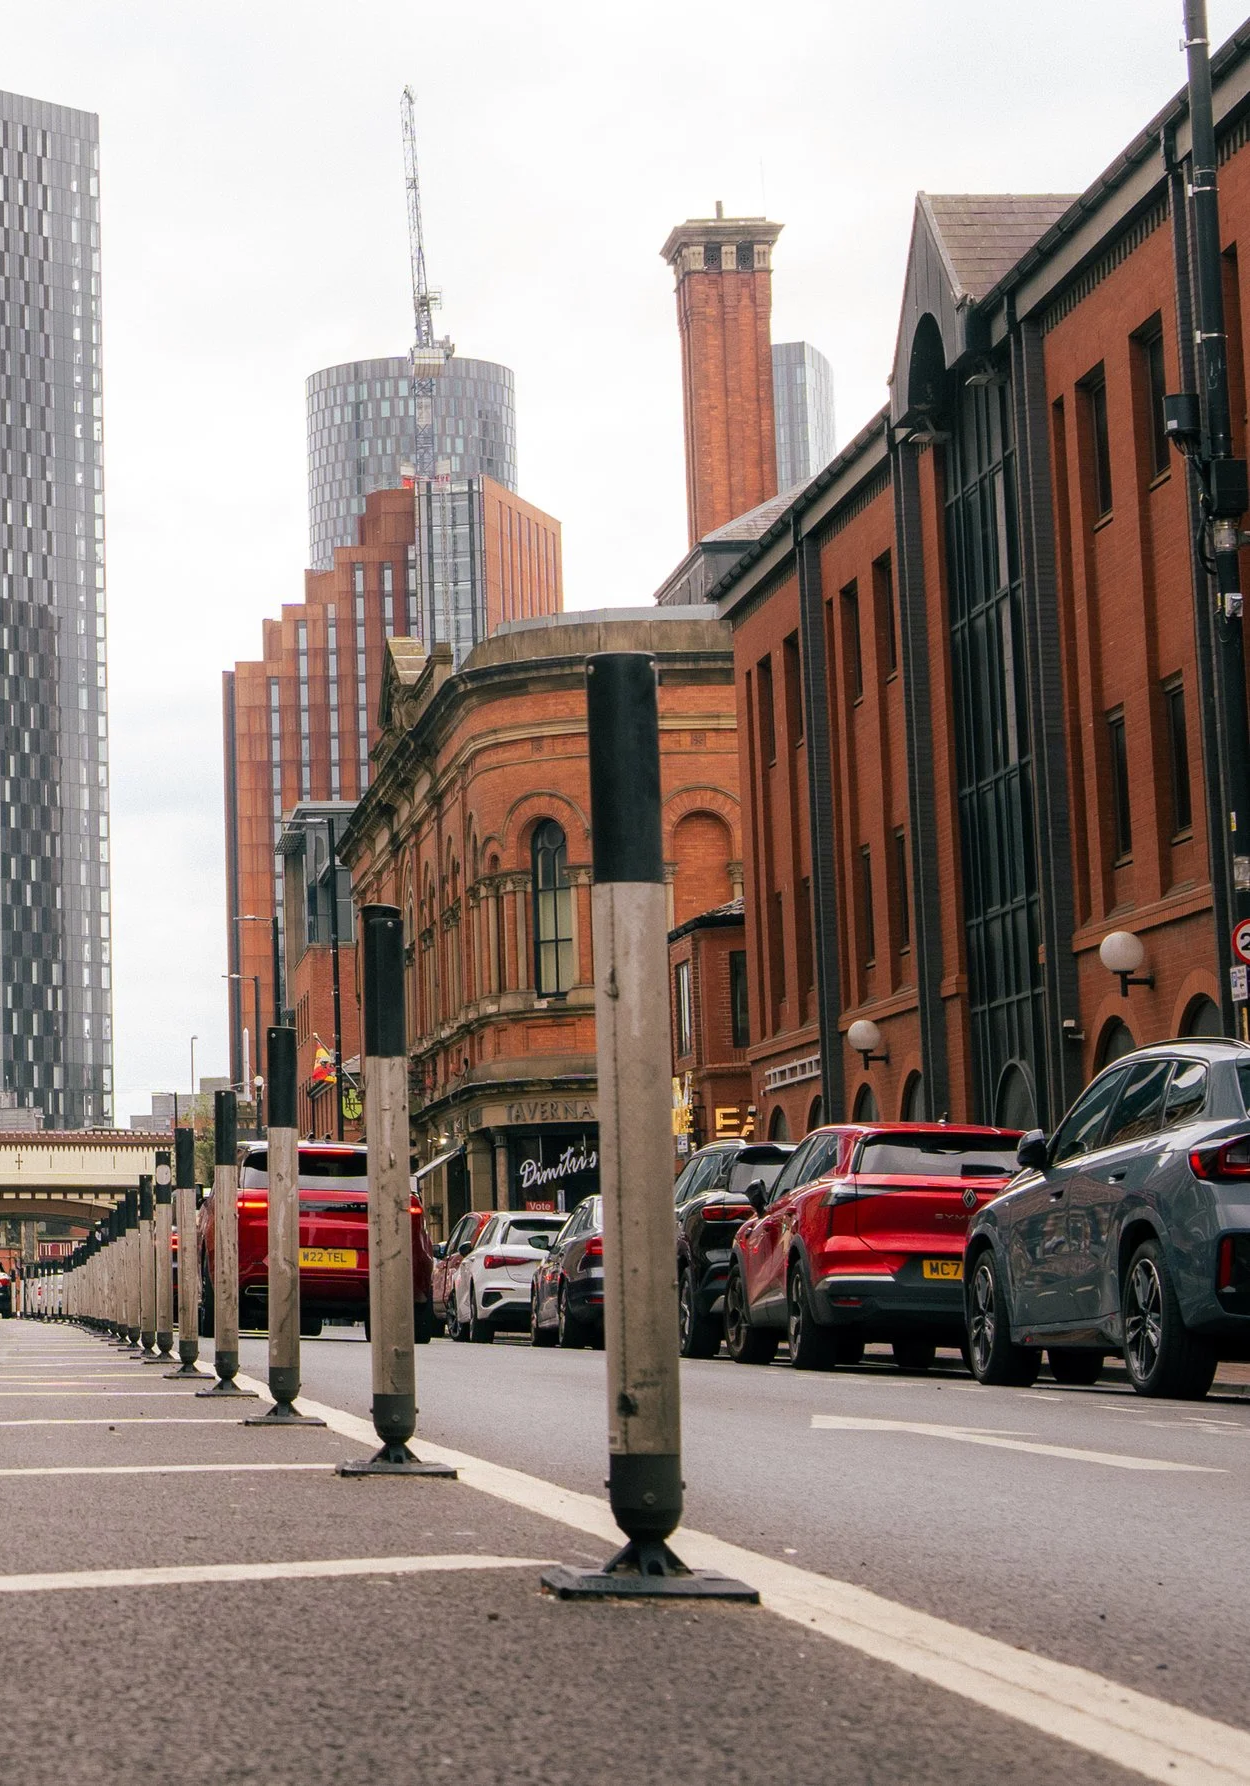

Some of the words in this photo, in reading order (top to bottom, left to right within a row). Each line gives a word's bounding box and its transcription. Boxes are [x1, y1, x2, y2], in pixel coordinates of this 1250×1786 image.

[505, 1100, 595, 1122] TAVERNA
[529, 1202, 551, 1211] Vote
[302, 1252, 323, 1262] W22
[327, 1252, 347, 1263] TEL
[930, 1262, 961, 1276] MC7
